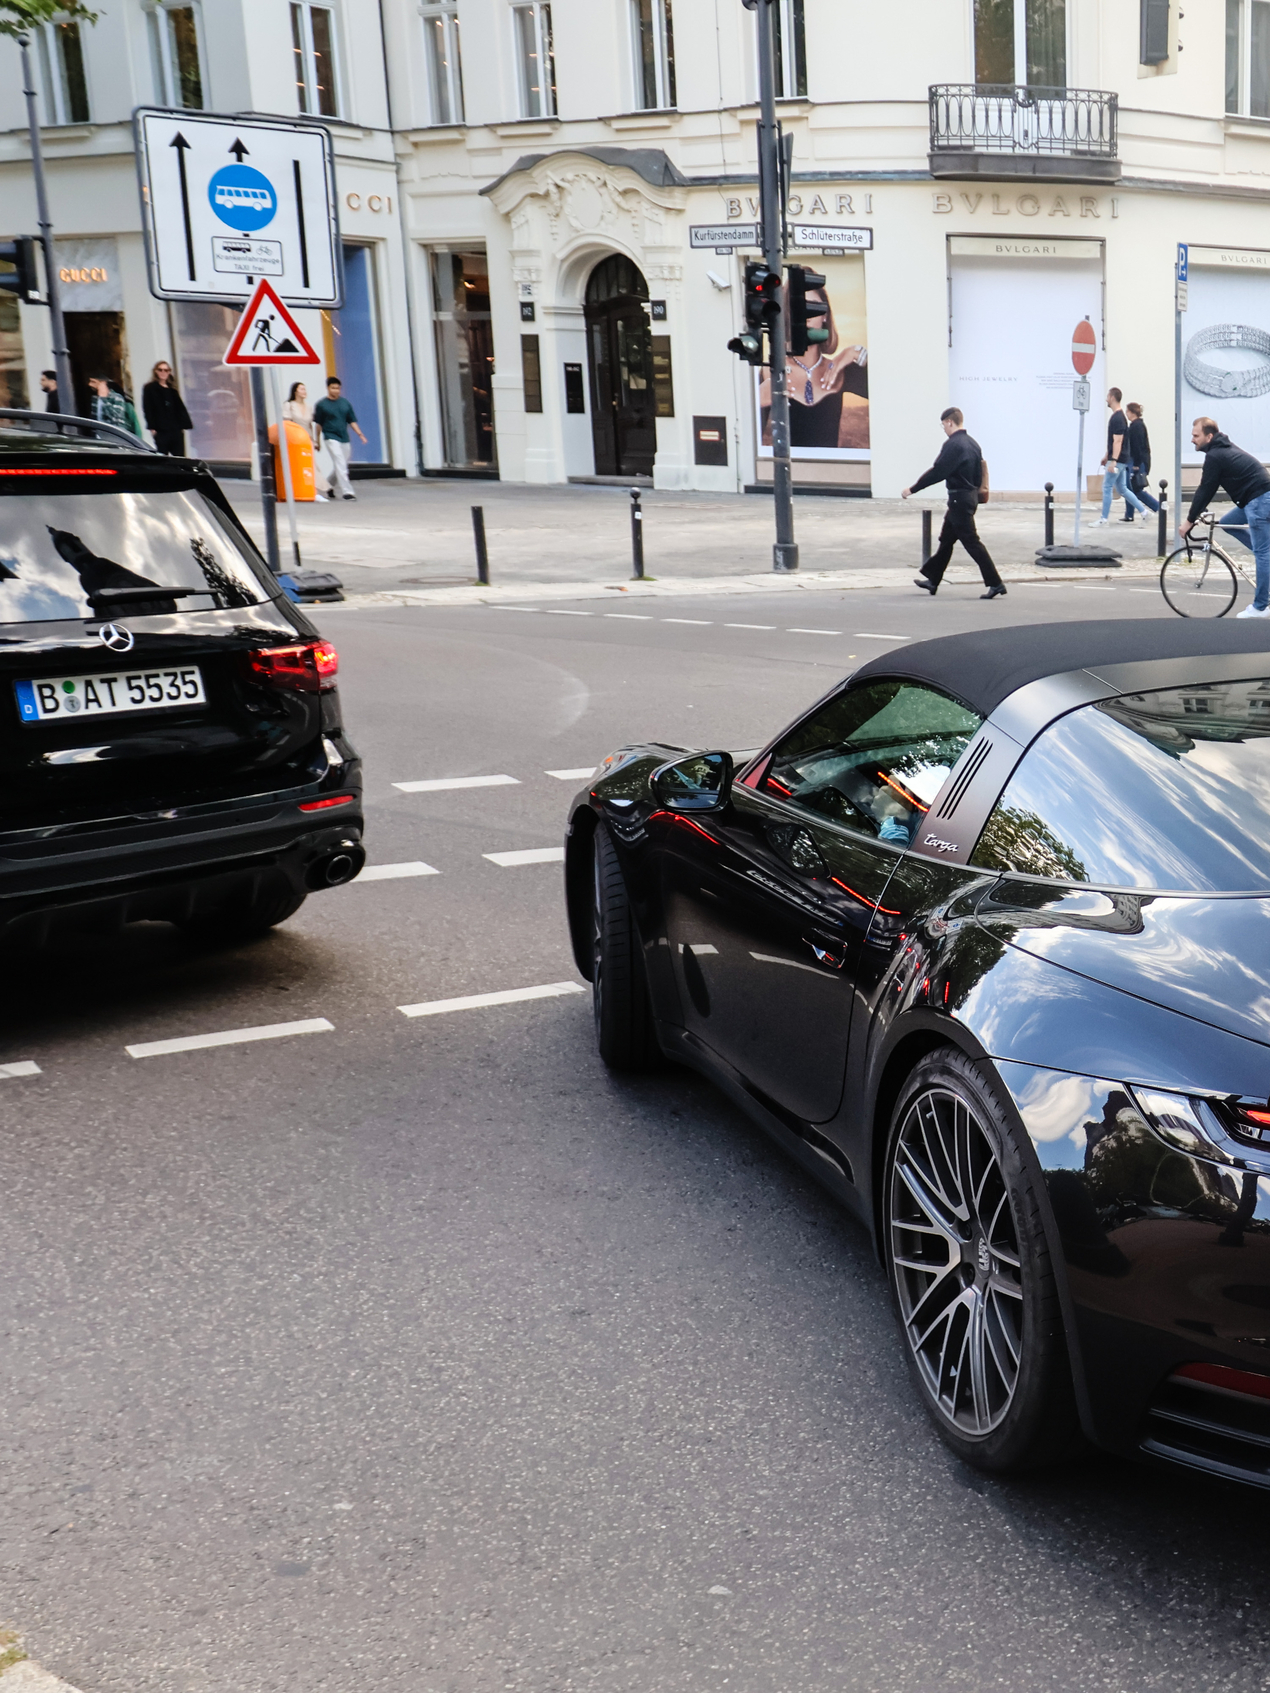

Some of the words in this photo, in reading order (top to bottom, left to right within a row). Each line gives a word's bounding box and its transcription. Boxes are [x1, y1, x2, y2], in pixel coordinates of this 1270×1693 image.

[345, 192, 393, 215] CCI
[727, 193, 873, 218] BVGARI
[932, 192, 1119, 219] BVLGARI
[693, 229, 755, 242] Kurfürstendamm
[801, 228, 864, 244] Schlüterstraße
[995, 244, 1057, 255] BVLGARI
[215, 252, 280, 266] Krankenfahrzeuge
[1220, 254, 1267, 265] BVLGARI
[60, 266, 108, 283] GUCCI
[36, 683, 60, 714] B
[84, 677, 118, 710] AT
[125, 670, 199, 705] 5535
[924, 833, 958, 853] targa
